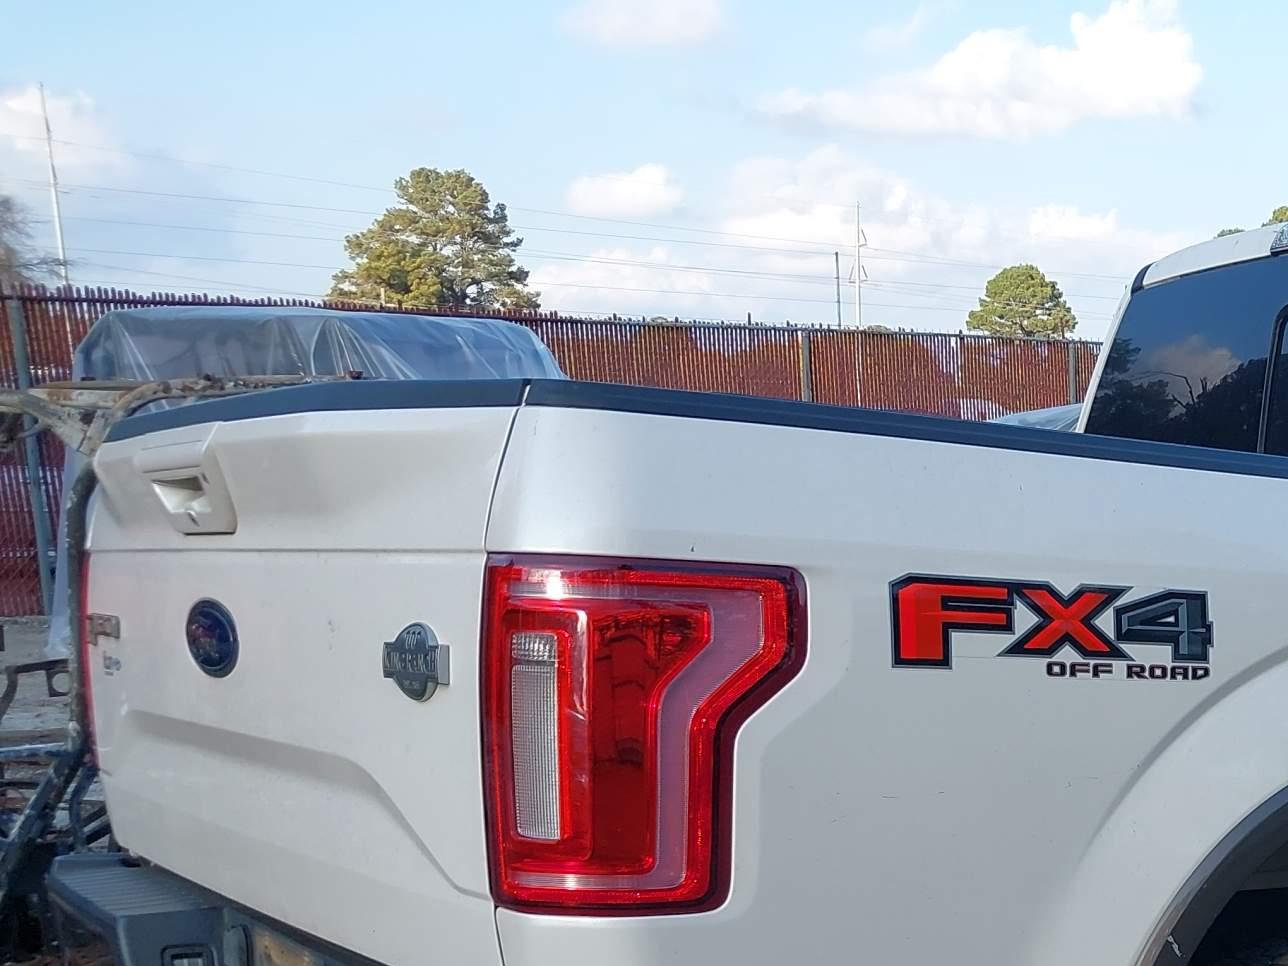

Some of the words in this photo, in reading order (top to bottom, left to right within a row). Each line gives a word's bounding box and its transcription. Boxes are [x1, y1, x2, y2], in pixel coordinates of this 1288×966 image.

[889, 572, 1214, 670] FX4
[1046, 661, 1113, 679] OFF
[1126, 662, 1210, 681] ROAD
